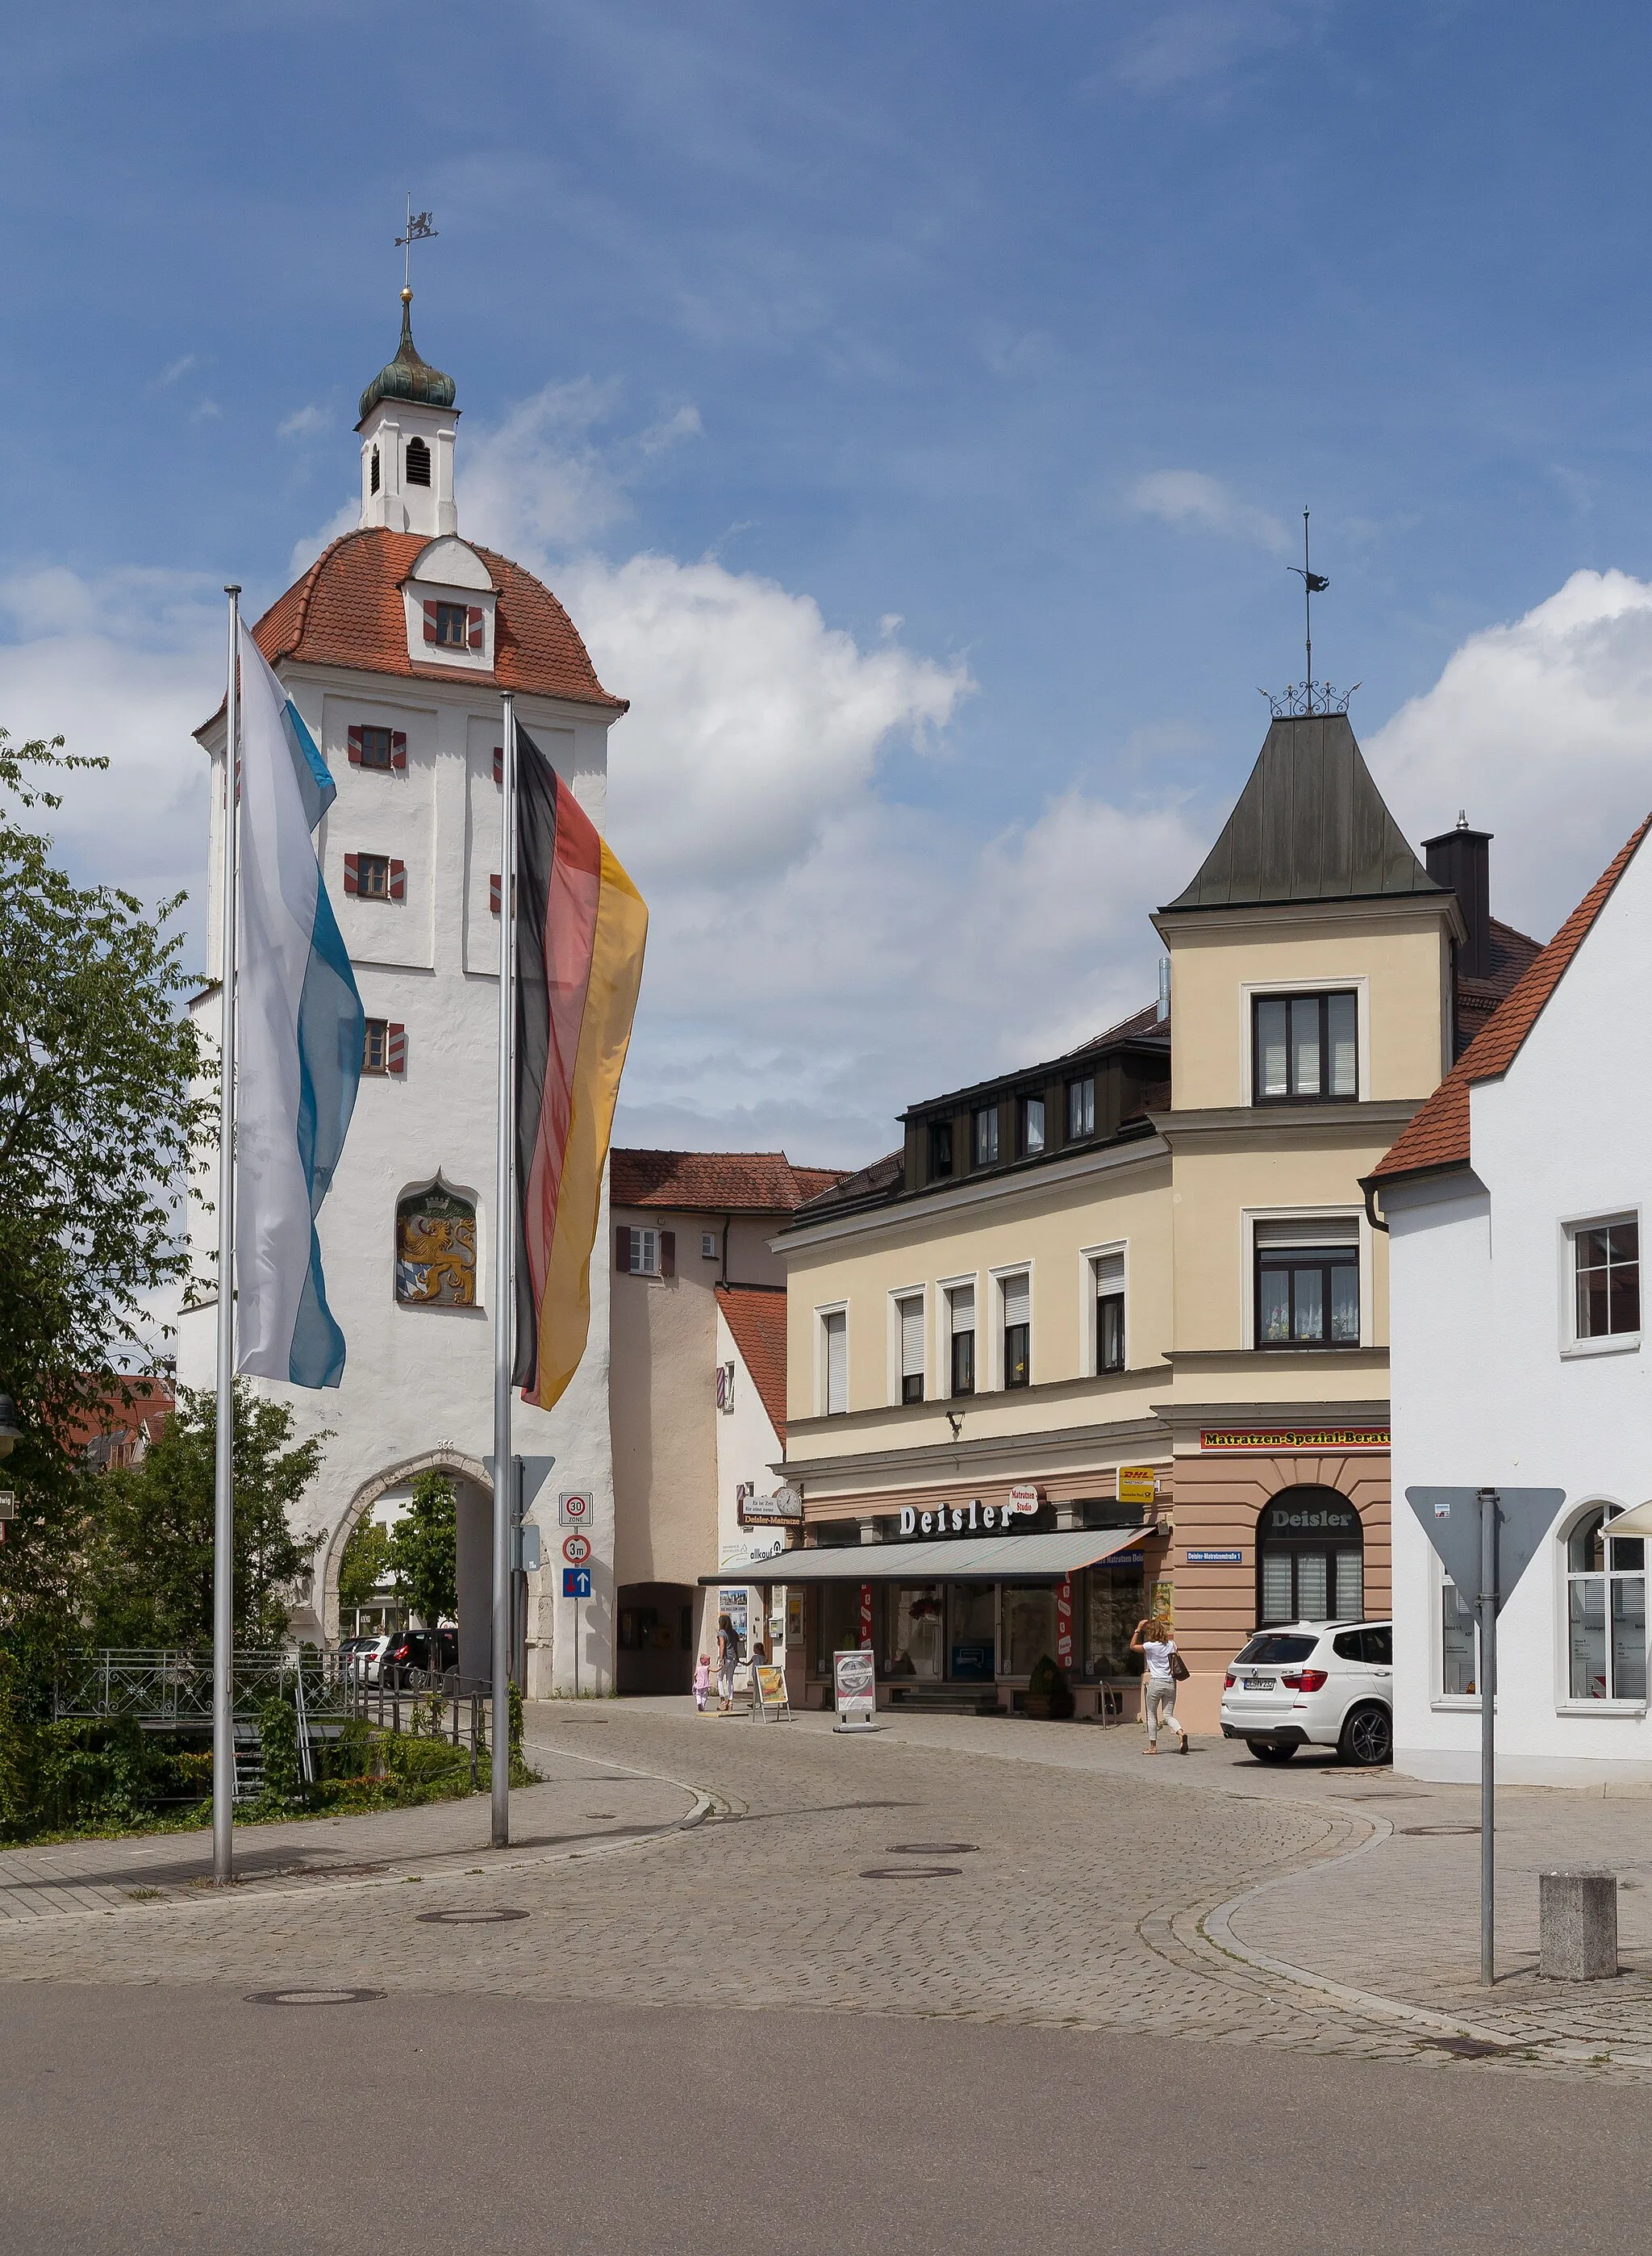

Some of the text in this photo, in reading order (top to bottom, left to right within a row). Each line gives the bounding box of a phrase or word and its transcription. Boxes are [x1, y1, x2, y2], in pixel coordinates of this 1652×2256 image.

[570, 1502, 582, 1510] 30
[1016, 1502, 1032, 1511] Studio
[745, 1515, 800, 1525] Deisler-Matratze
[899, 1499, 1013, 1535] Deisler
[1272, 1510, 1352, 1527] Deisler
[750, 1548, 773, 1560] allkauf
